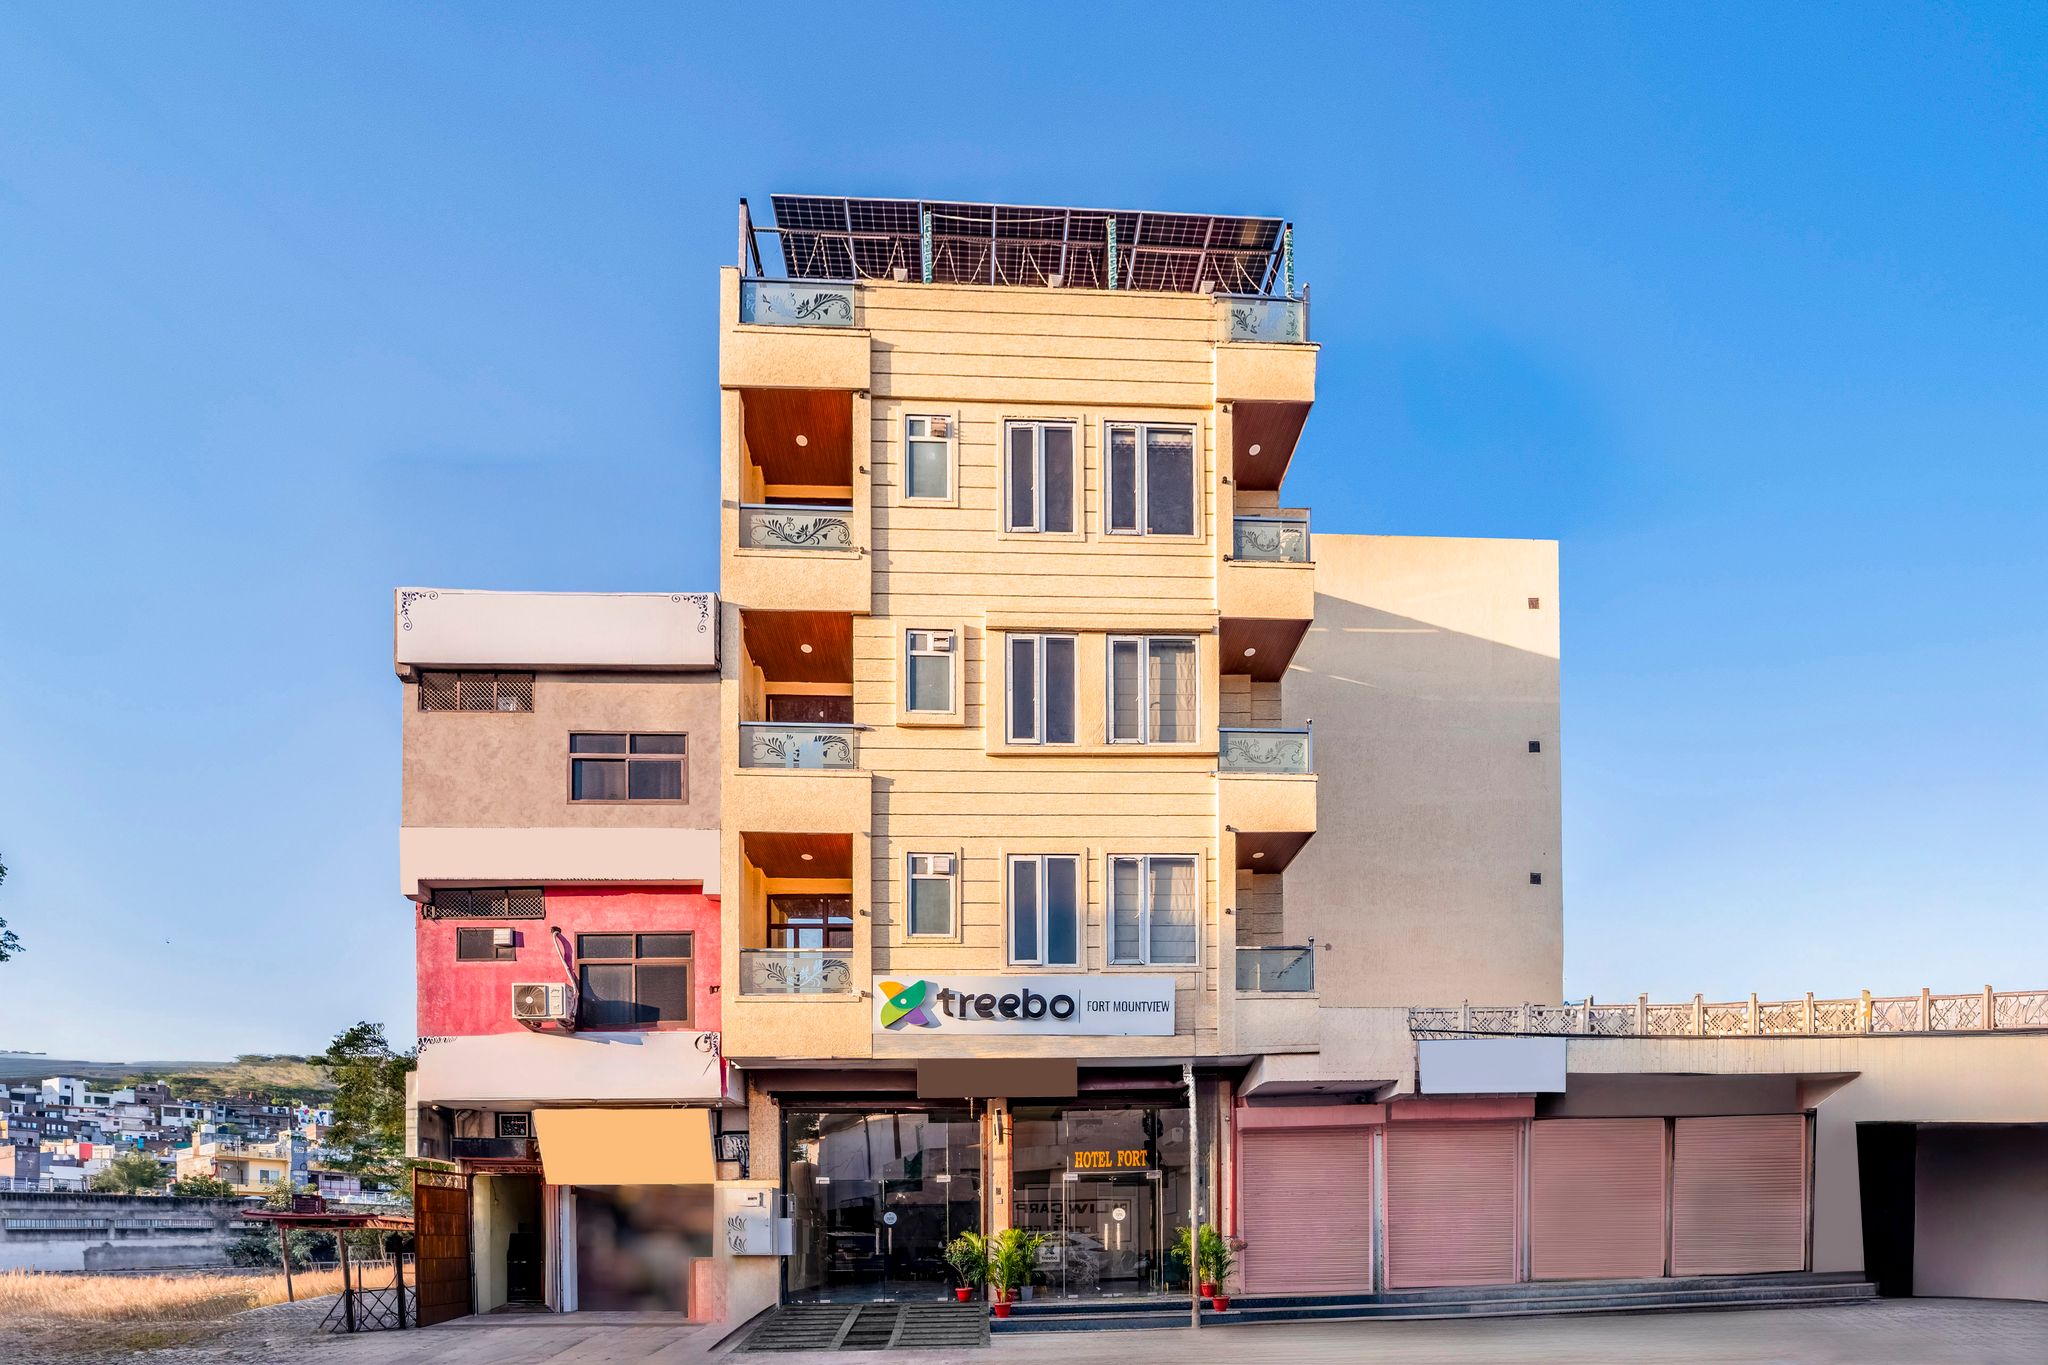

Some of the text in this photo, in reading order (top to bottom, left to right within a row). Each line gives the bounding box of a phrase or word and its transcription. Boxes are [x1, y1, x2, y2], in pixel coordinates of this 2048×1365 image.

[937, 988, 1170, 1019] treebo FORT MOUNTVIEW
[1074, 1150, 1148, 1168] HOTEL FORT
